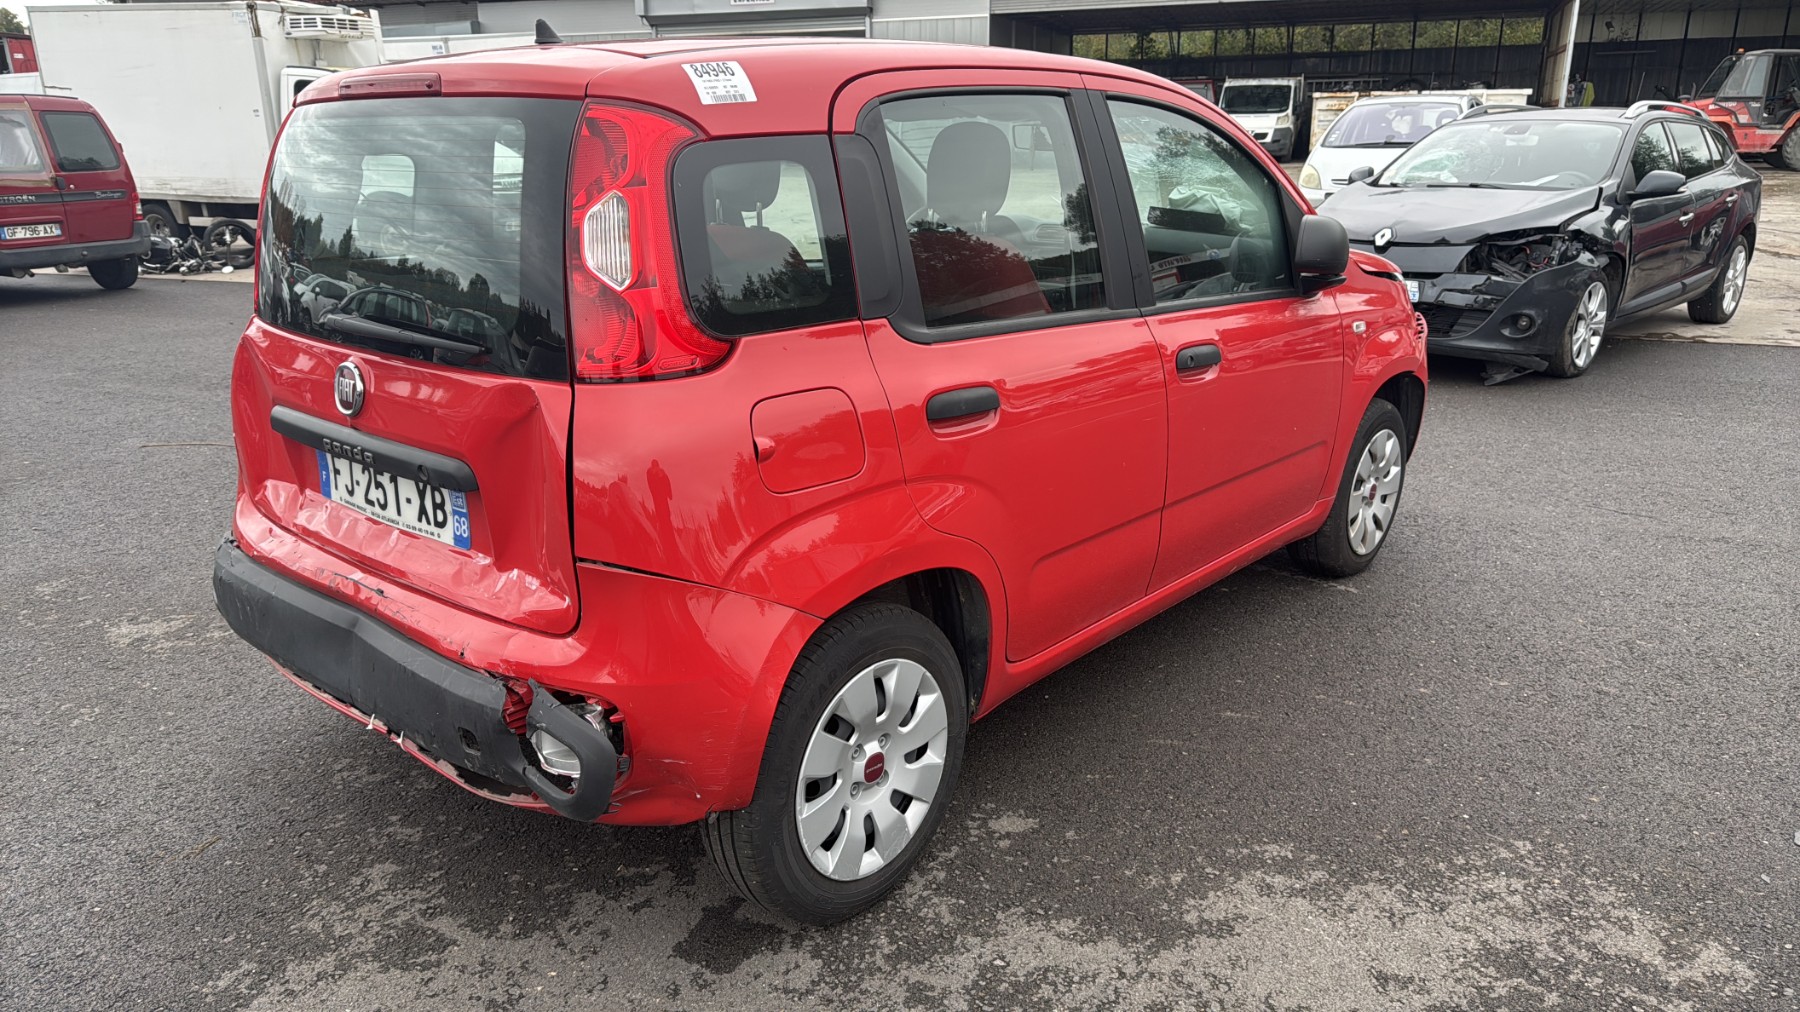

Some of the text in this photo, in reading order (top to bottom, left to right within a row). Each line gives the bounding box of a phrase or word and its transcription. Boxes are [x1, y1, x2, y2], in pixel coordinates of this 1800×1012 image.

[690, 62, 735, 78] 84946
[0, 194, 36, 203] ITROËN
[6, 225, 55, 237] GF-796-AX
[339, 377, 355, 402] FIAT
[322, 438, 374, 465] panda
[322, 470, 327, 482] F
[331, 453, 448, 529] FJ-251-XB
[454, 515, 468, 537] 68
